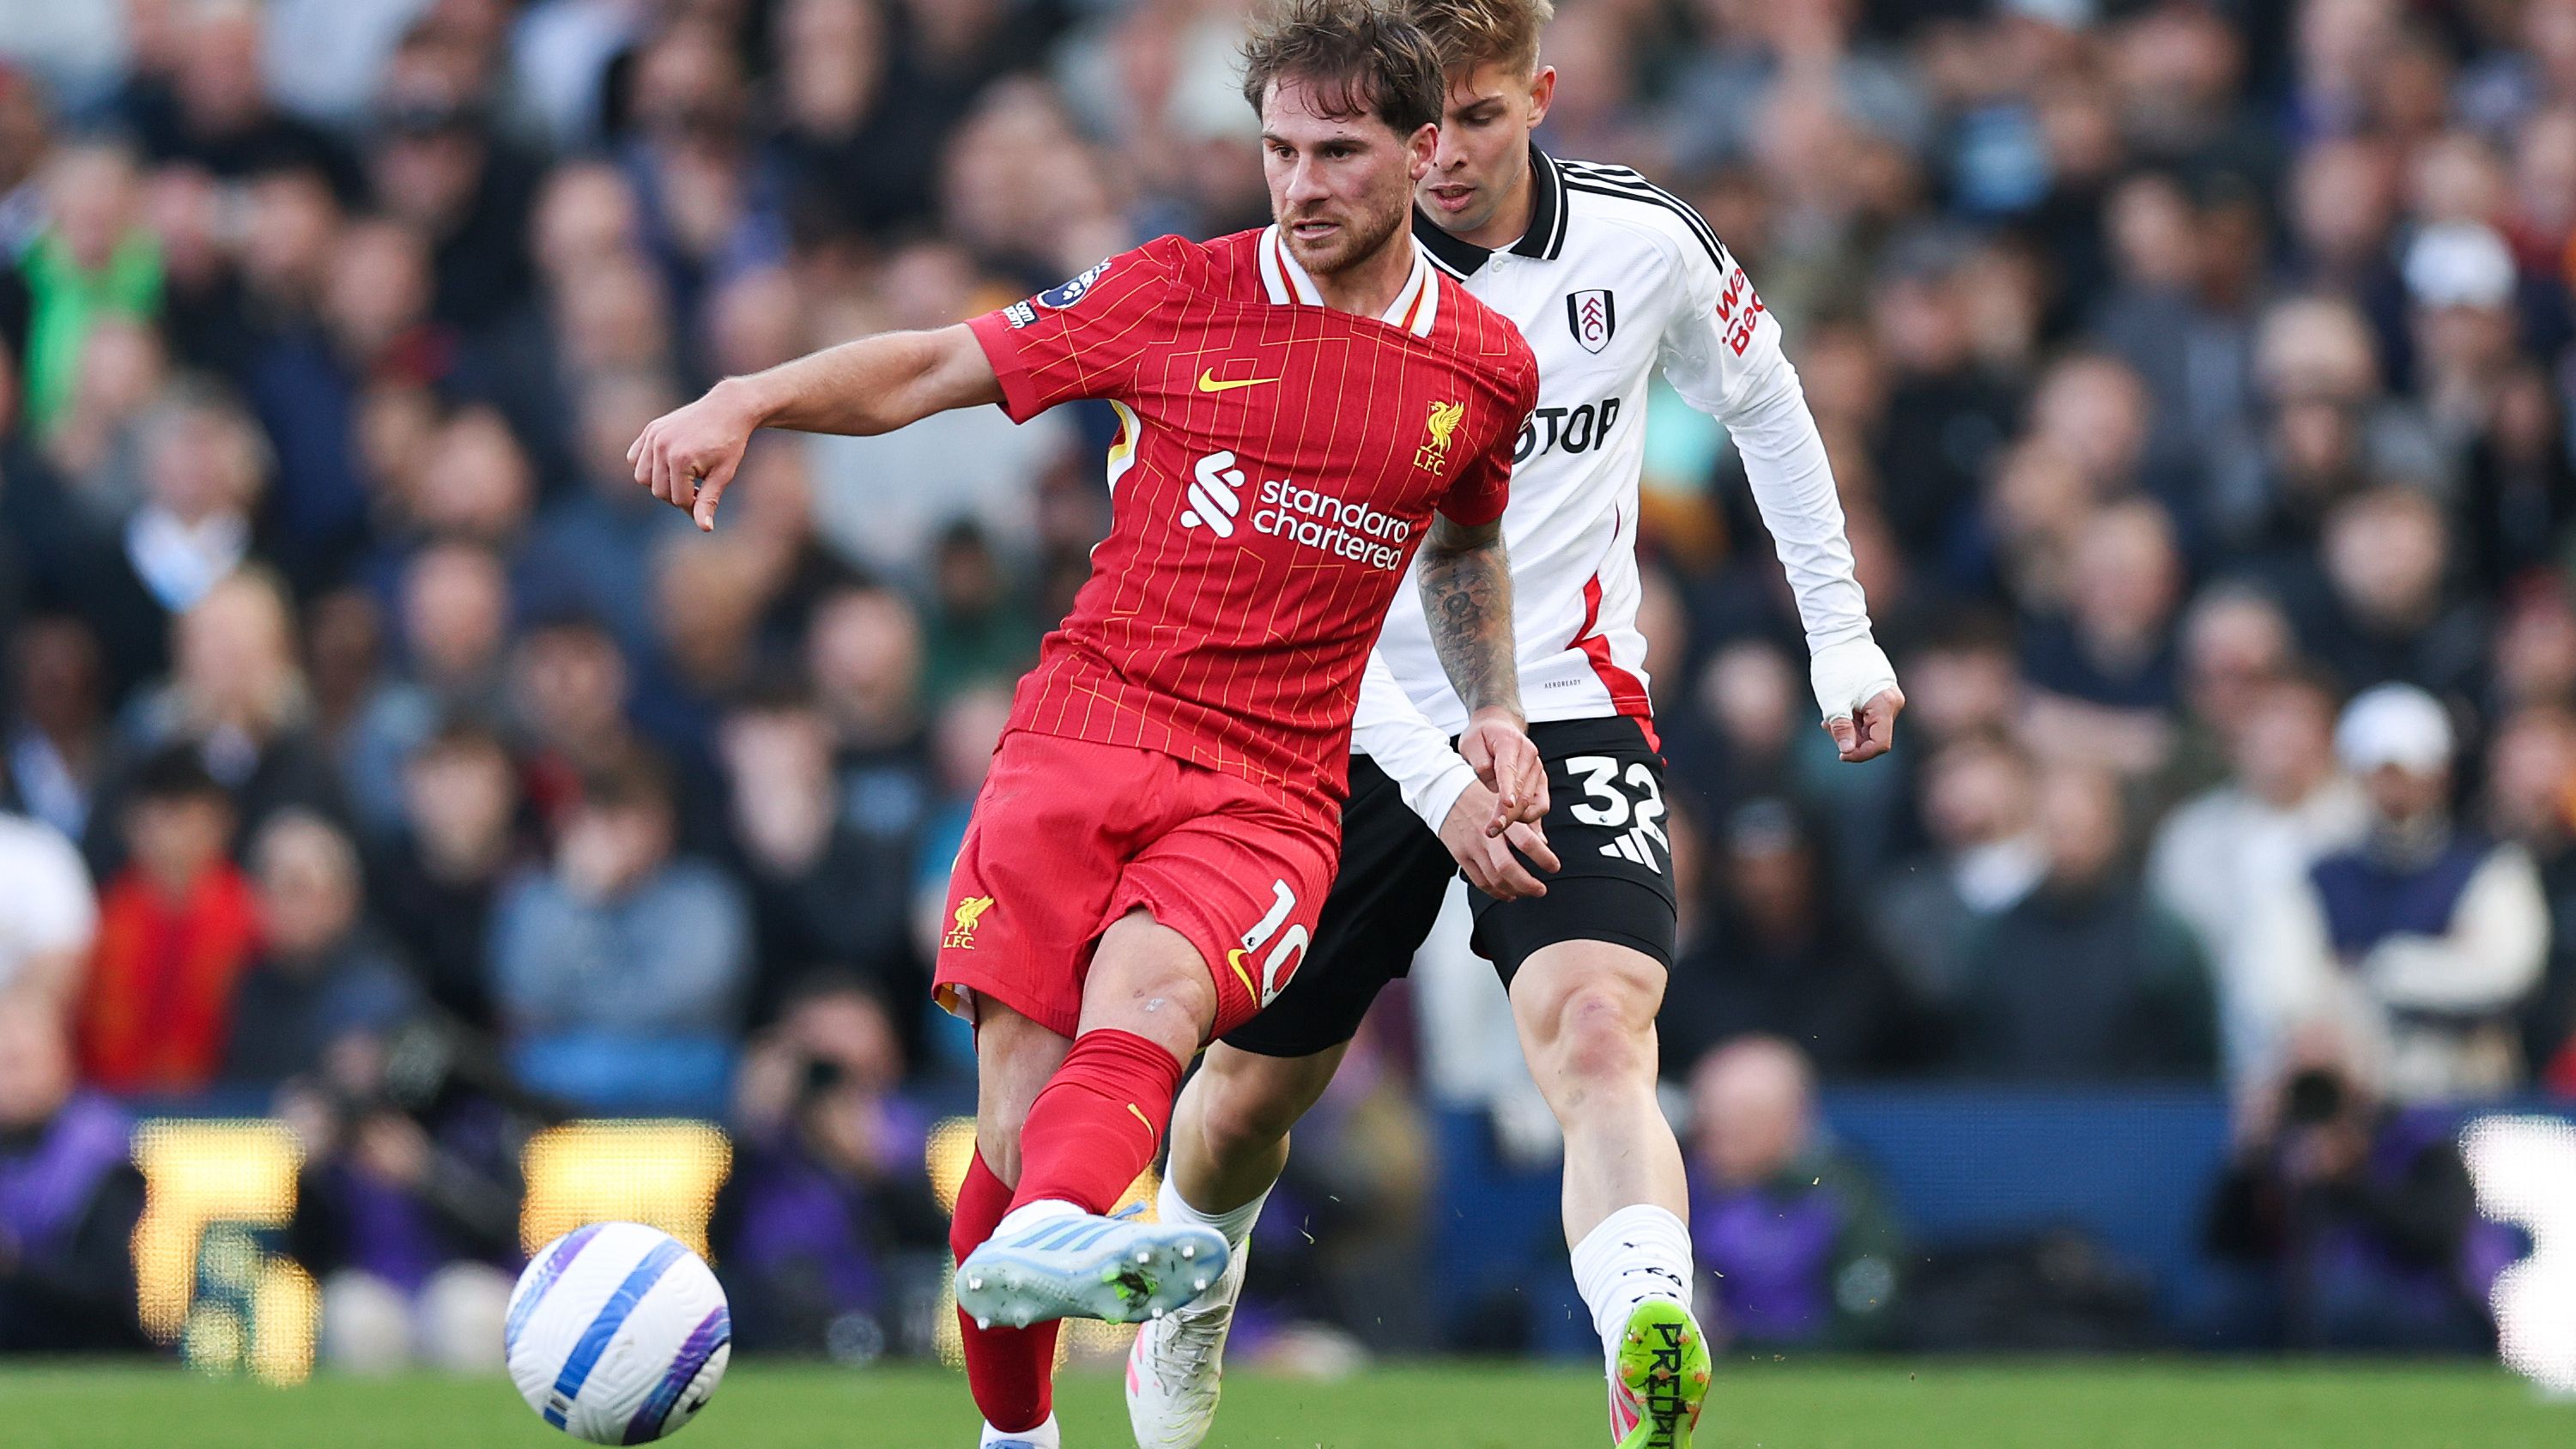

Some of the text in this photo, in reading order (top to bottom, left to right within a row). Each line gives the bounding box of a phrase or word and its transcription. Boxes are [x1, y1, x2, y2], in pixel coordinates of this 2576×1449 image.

[1253, 509, 1404, 572] chartered
[1260, 478, 1414, 543] standard
[1565, 755, 1670, 854] 32
[1240, 877, 1309, 1009] 10
